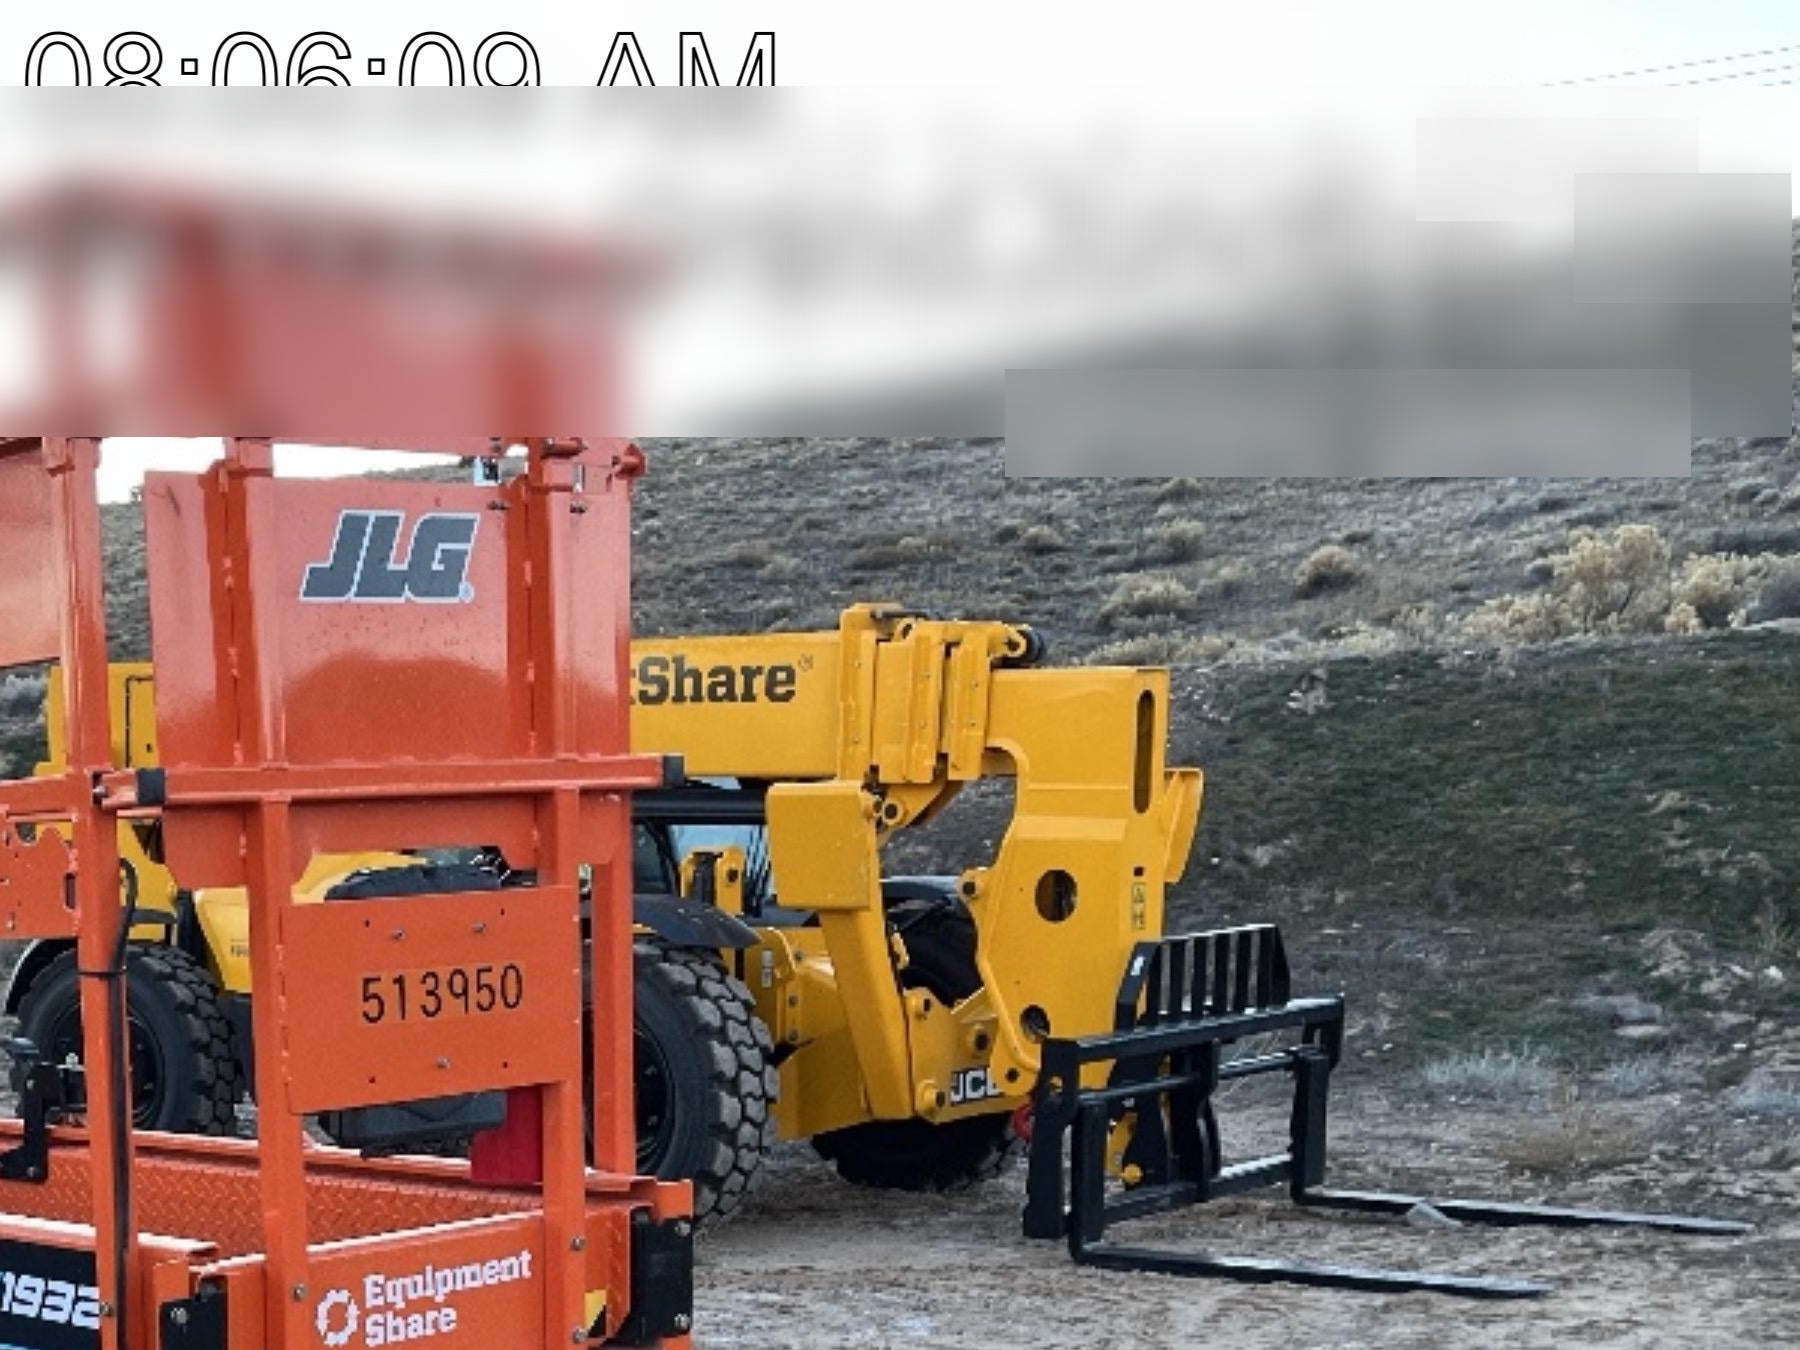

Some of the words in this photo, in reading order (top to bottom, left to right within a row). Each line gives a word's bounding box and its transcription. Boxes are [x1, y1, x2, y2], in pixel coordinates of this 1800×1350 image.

[299, 508, 481, 604] JLG
[630, 653, 796, 705] Share
[361, 962, 524, 1025] 513950
[363, 1248, 533, 1310] Equipment
[364, 1306, 458, 1349] Share
